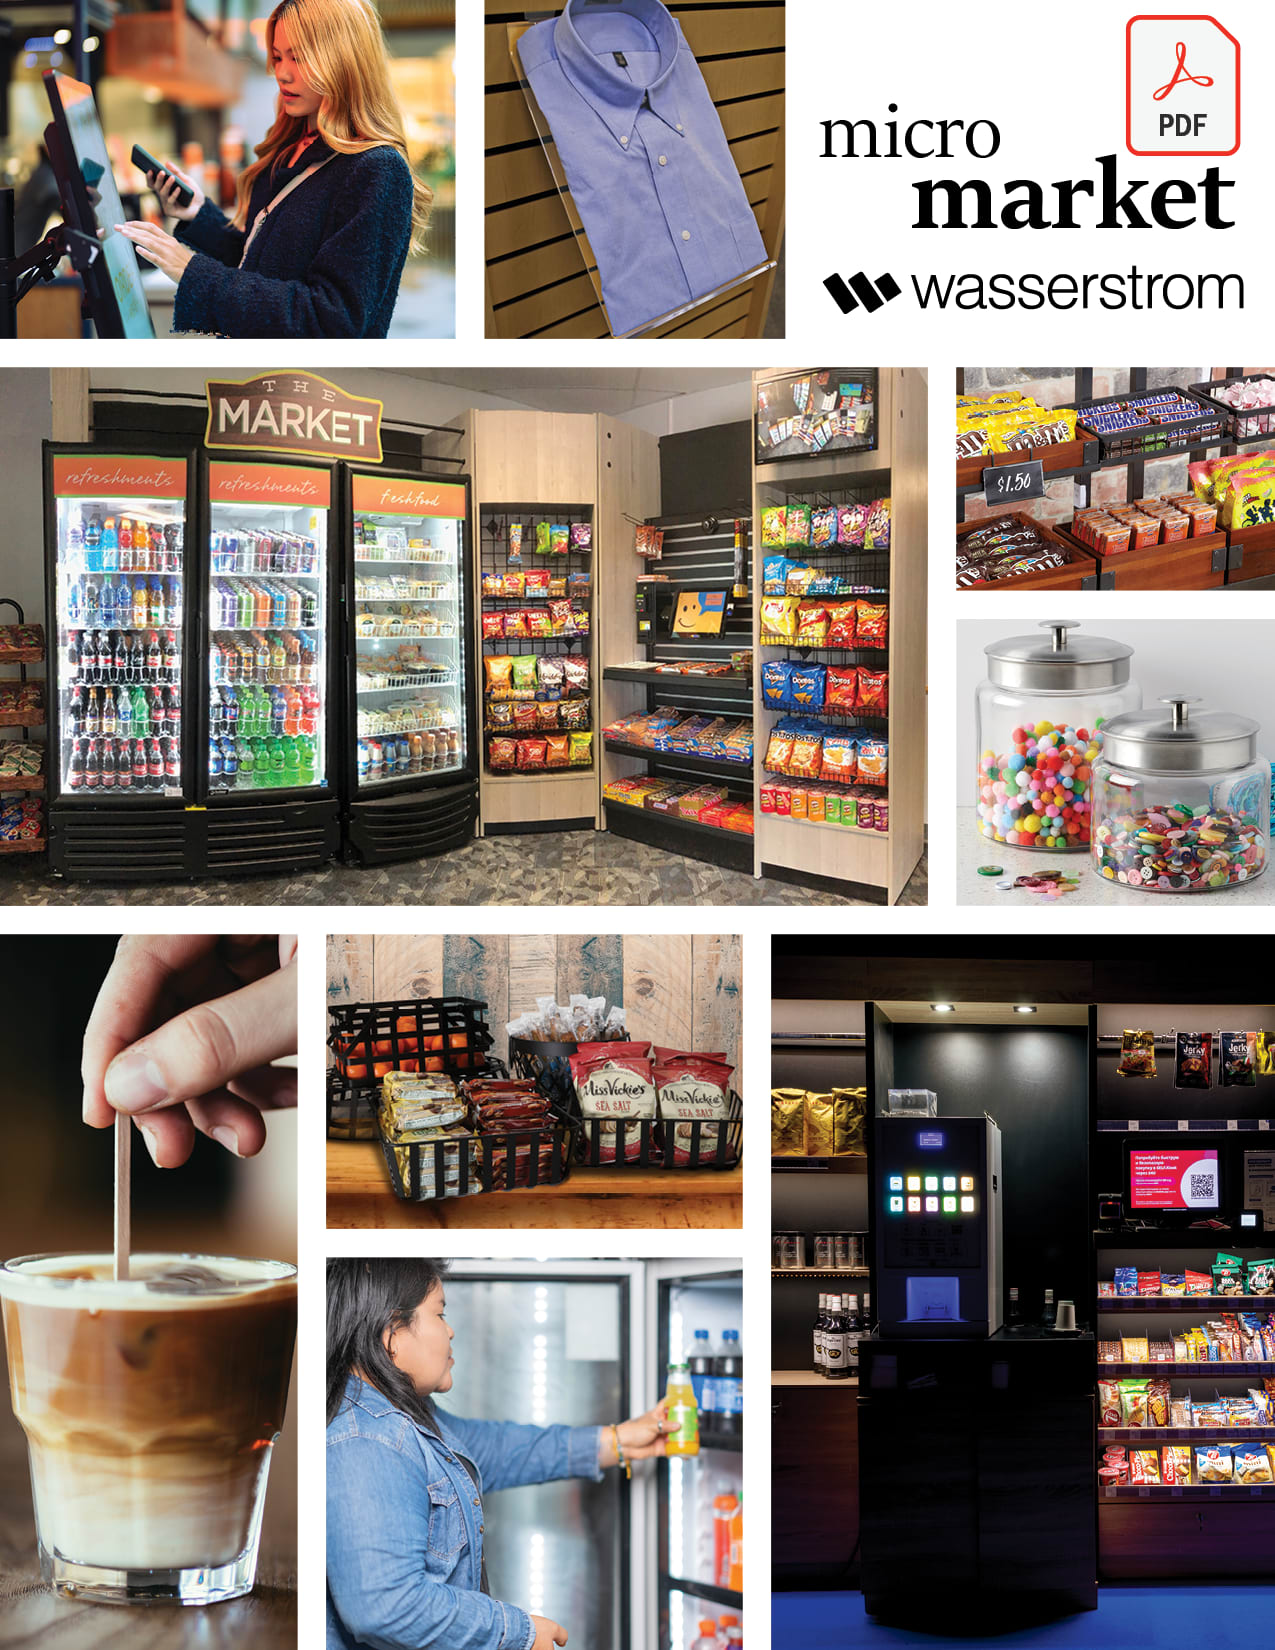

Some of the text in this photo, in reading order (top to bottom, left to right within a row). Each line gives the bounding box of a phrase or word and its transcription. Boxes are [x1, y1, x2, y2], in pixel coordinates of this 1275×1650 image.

[1127, 391, 1178, 408] SNICKERS
[1148, 401, 1200, 416] SNICKERS
[218, 397, 373, 446] MARKET
[1083, 409, 1138, 427] SNICKERS
[1096, 415, 1150, 432] SNICKERS
[65, 467, 176, 488] refreshments
[218, 474, 320, 496] refreshments
[997, 472, 1032, 494] $1.50
[764, 672, 786, 681] Doritos
[792, 676, 815, 684] Doritos
[828, 675, 850, 685] Doritos
[1184, 1044, 1206, 1056] Jerky
[1228, 1043, 1250, 1055] Jerky
[605, 1077, 647, 1099] Vickie's
[595, 1100, 632, 1111] SEA SALT
[678, 1108, 714, 1118] SEA SALT
